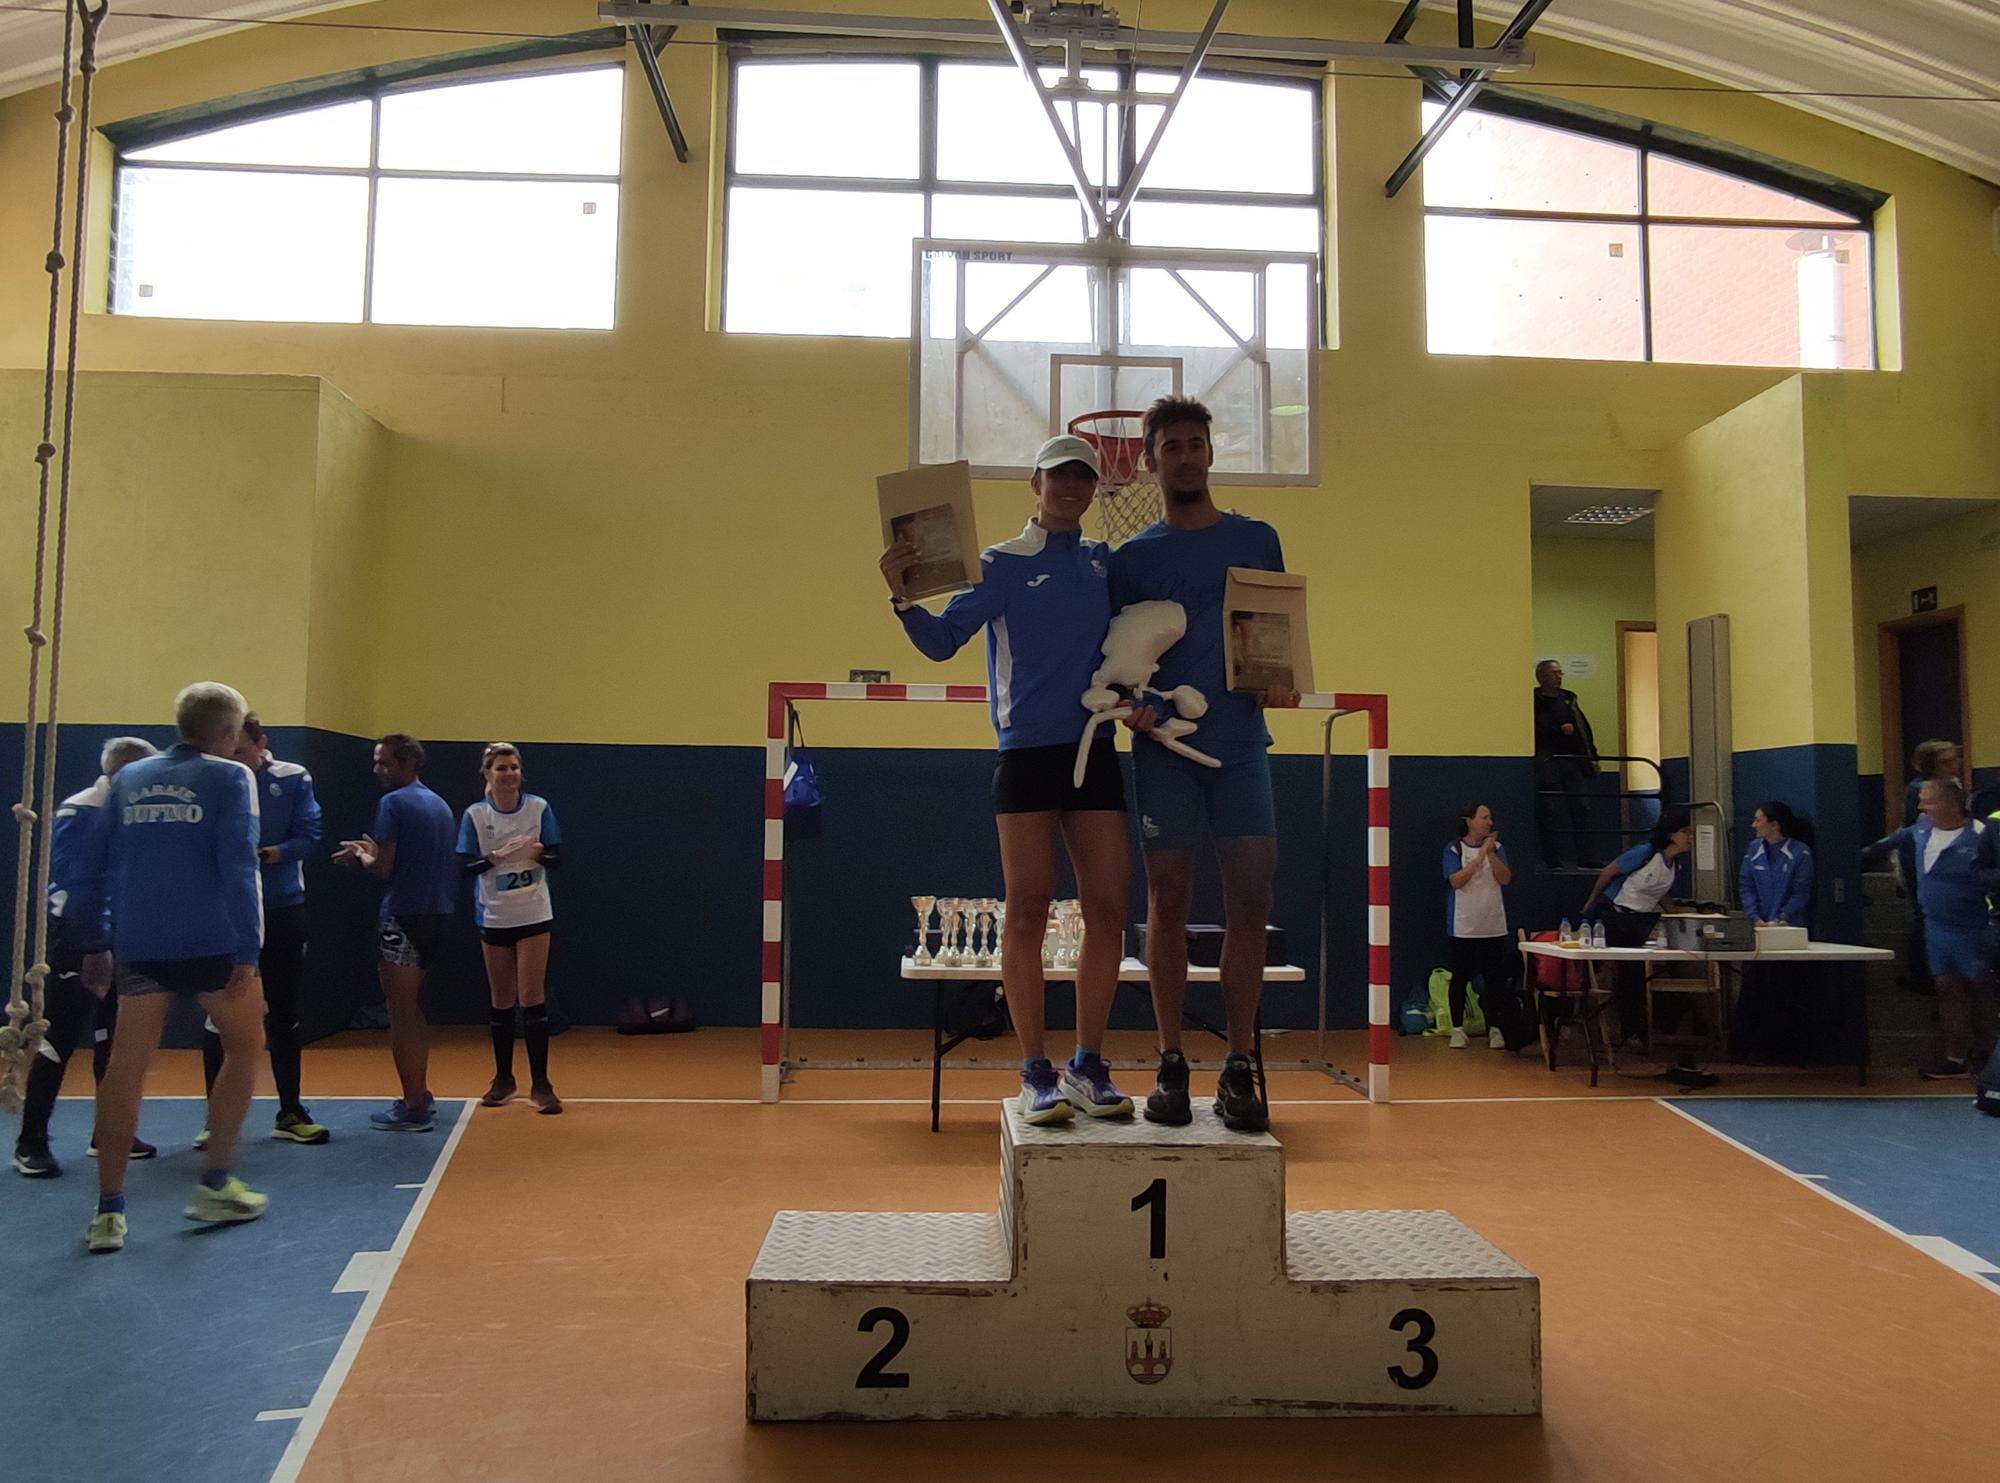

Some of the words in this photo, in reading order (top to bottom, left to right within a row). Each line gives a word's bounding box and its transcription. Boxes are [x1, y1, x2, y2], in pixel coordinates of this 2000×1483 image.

[973, 250, 1013, 262] SPORT
[507, 870, 533, 889] 29
[1131, 1179, 1167, 1259] 1
[855, 1307, 910, 1388] 2
[1387, 1309, 1438, 1389] 3
